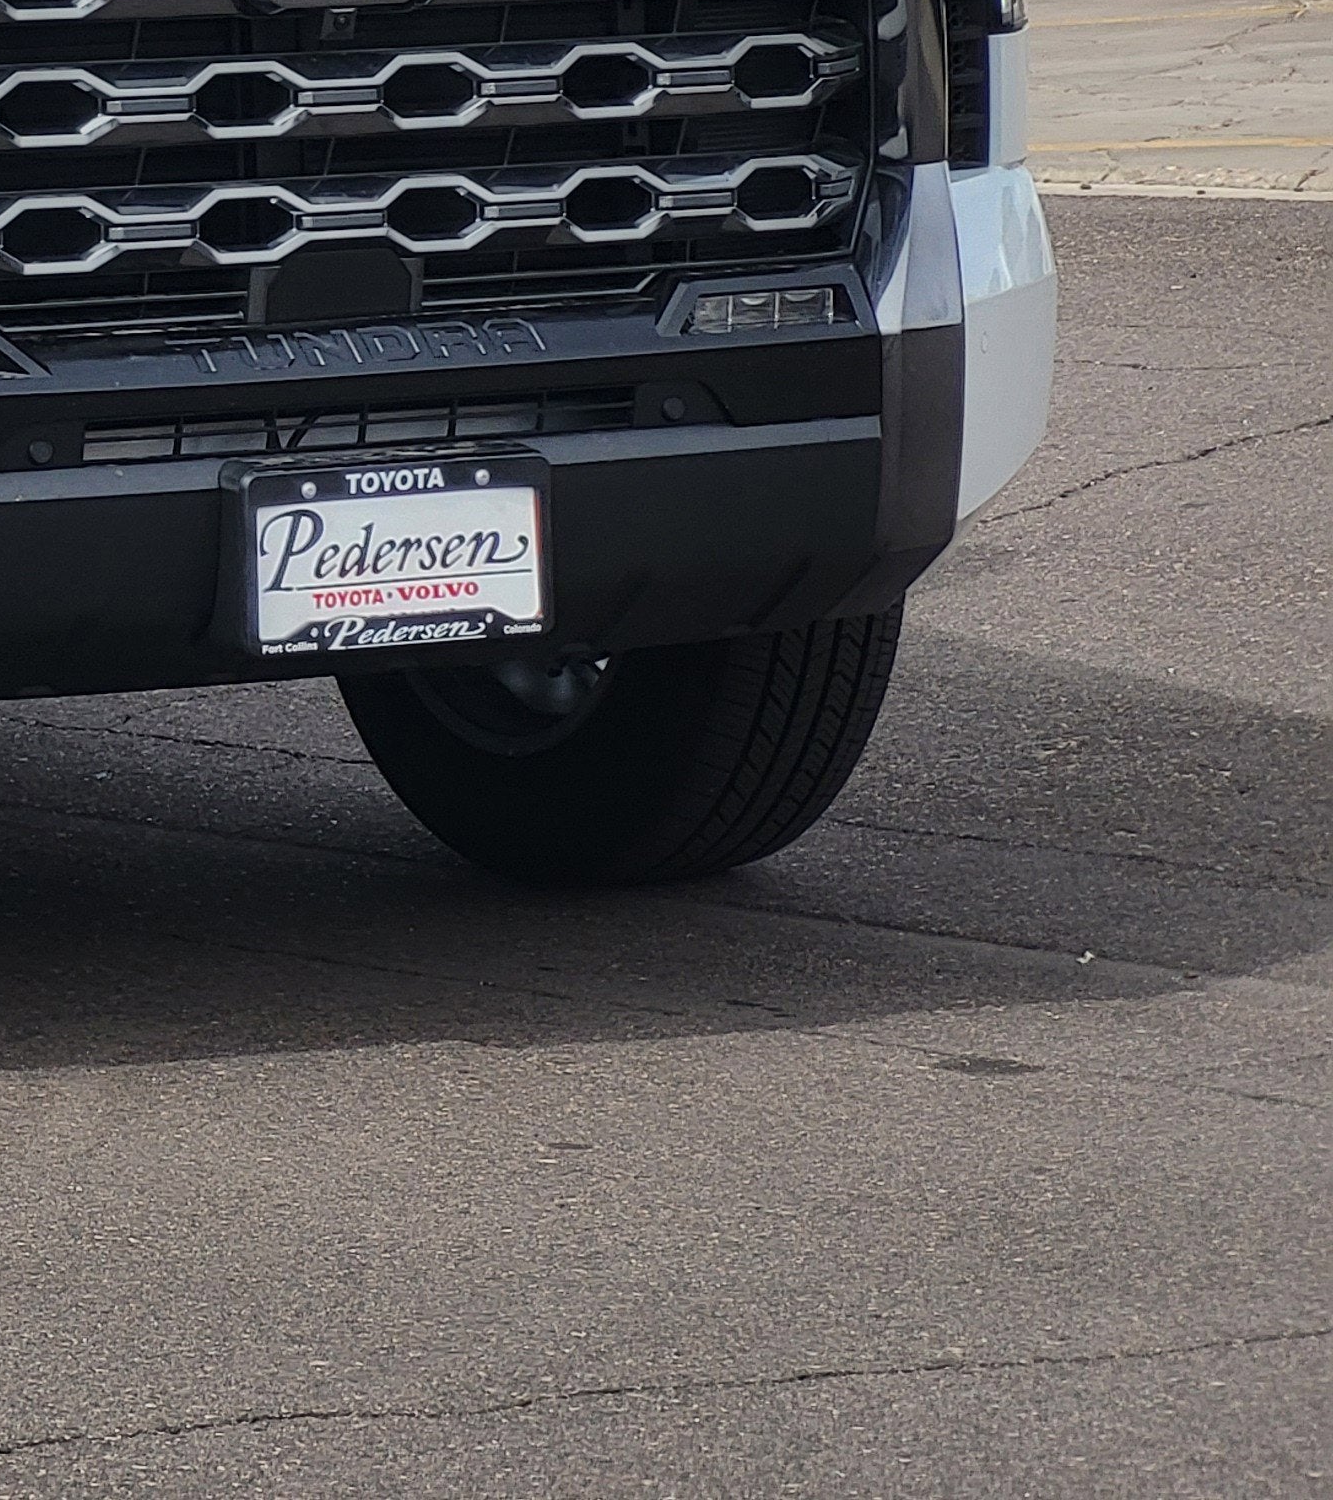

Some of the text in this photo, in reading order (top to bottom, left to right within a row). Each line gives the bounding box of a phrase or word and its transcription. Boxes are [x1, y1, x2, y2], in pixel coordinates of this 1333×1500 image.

[164, 317, 546, 373] TUNDRA
[345, 467, 446, 495] TOYOTA
[259, 508, 531, 593] Pedersen
[312, 580, 479, 609] TOYOTA VOLVO
[323, 612, 488, 650] Pedersen
[503, 622, 543, 635] Colorado
[261, 643, 284, 655] Fort
